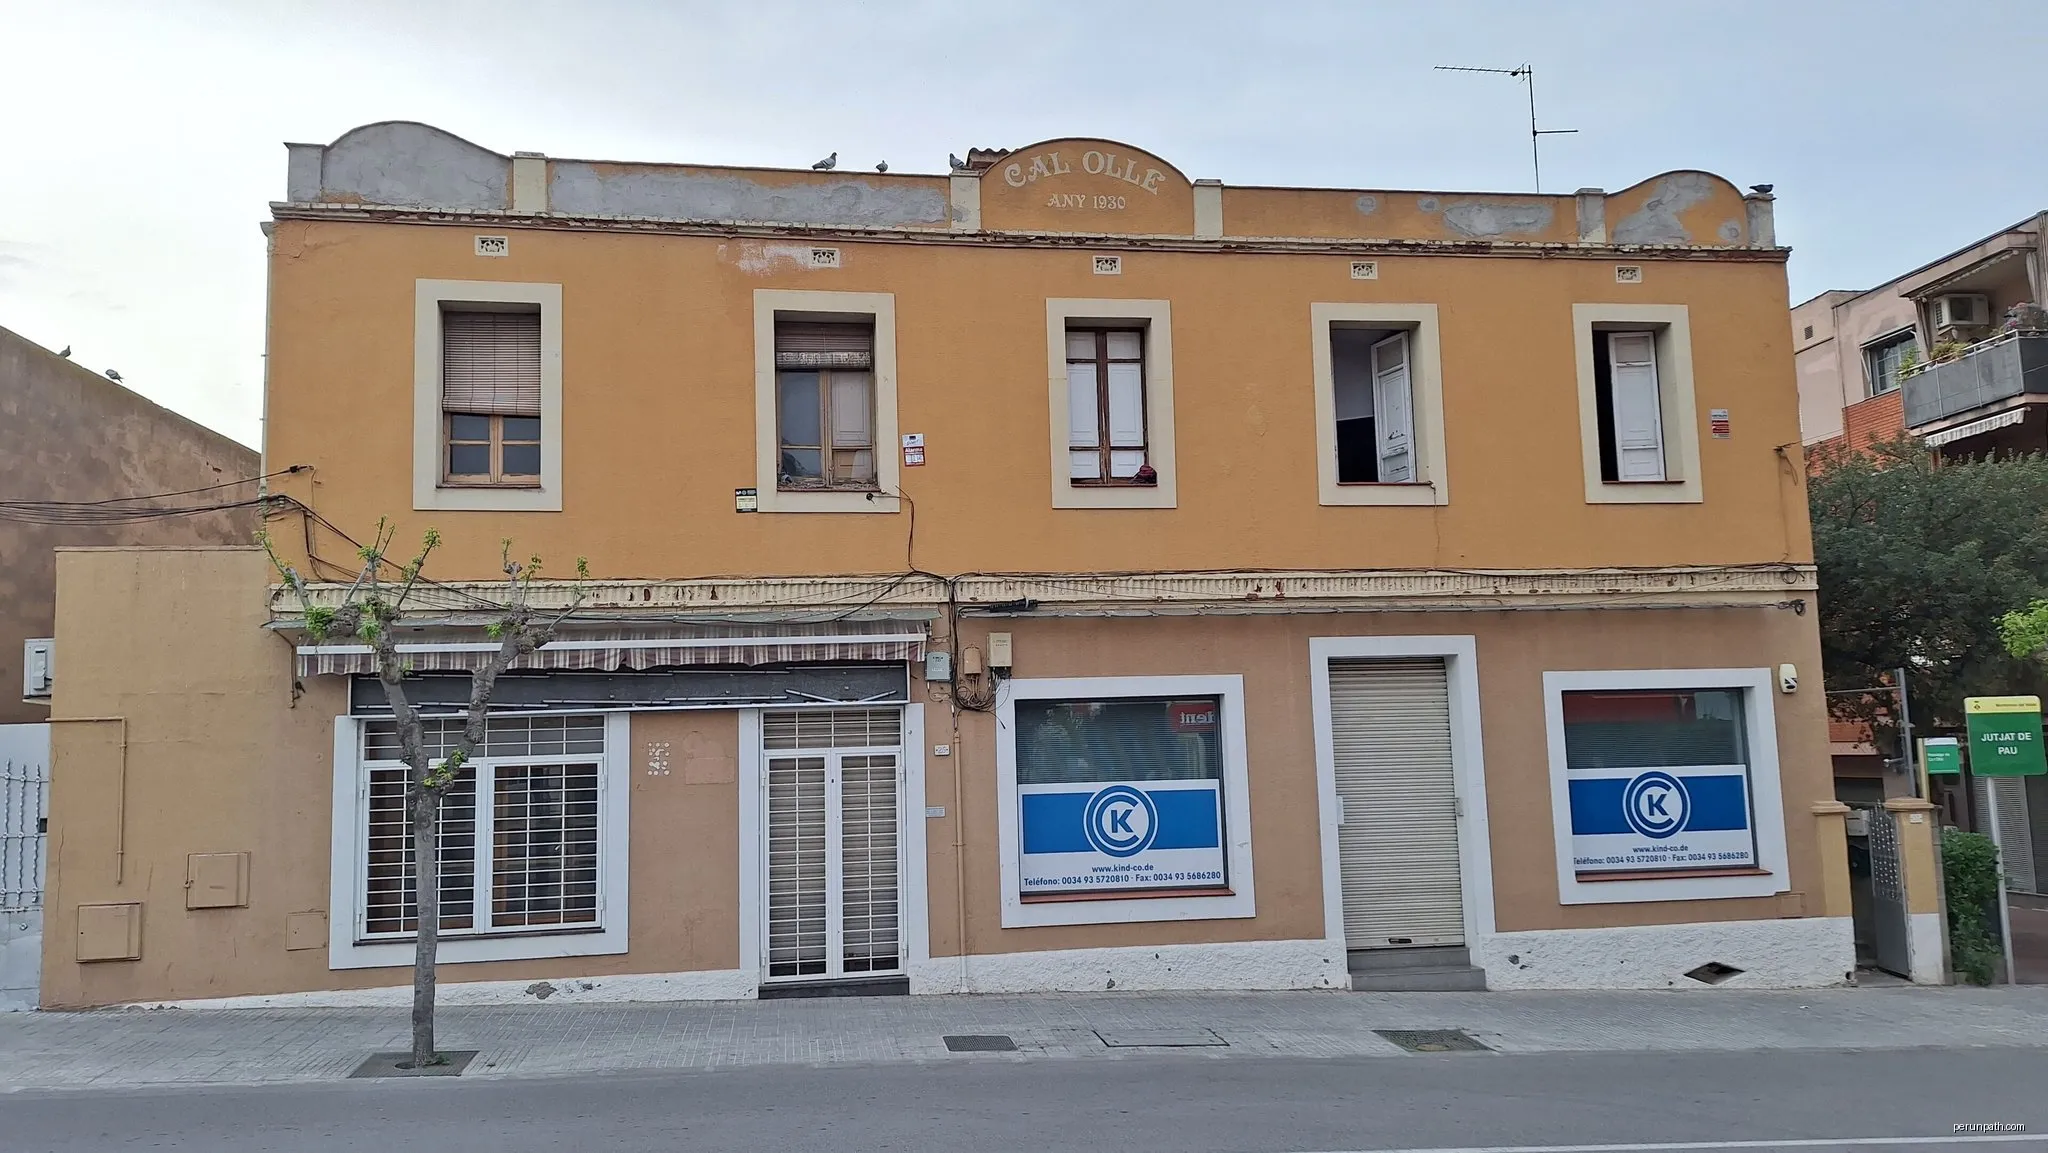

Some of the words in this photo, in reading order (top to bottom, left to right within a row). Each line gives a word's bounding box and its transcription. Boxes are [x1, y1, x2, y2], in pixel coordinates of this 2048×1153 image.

[1004, 151, 1071, 188] CAL
[1082, 150, 1166, 196] OLLE
[1047, 193, 1086, 208] ANY
[1093, 195, 1126, 209] 1930
[1981, 732, 2016, 742] JUTJAT
[2017, 732, 2032, 741] DE
[1998, 746, 2018, 755] PAU
[1632, 844, 1689, 853] www.kind-co.de
[1606, 856, 1625, 864] 0034
[1637, 854, 1667, 863] 5720810
[1672, 854, 1687, 862] Fax:
[1688, 853, 1706, 861] 0034
[1707, 852, 1716, 860] 93
[1091, 863, 1154, 873] www.kind-co.de
[1024, 877, 1060, 886] Teléfono:
[1062, 876, 1082, 885] 0034
[1084, 876, 1094, 884] 93
[1096, 874, 1130, 883] 5720810
[1135, 874, 1152, 882] Fax:
[1153, 873, 1173, 881] 0034
[1175, 872, 1185, 880] 93
[1187, 871, 1221, 880] 5686280
